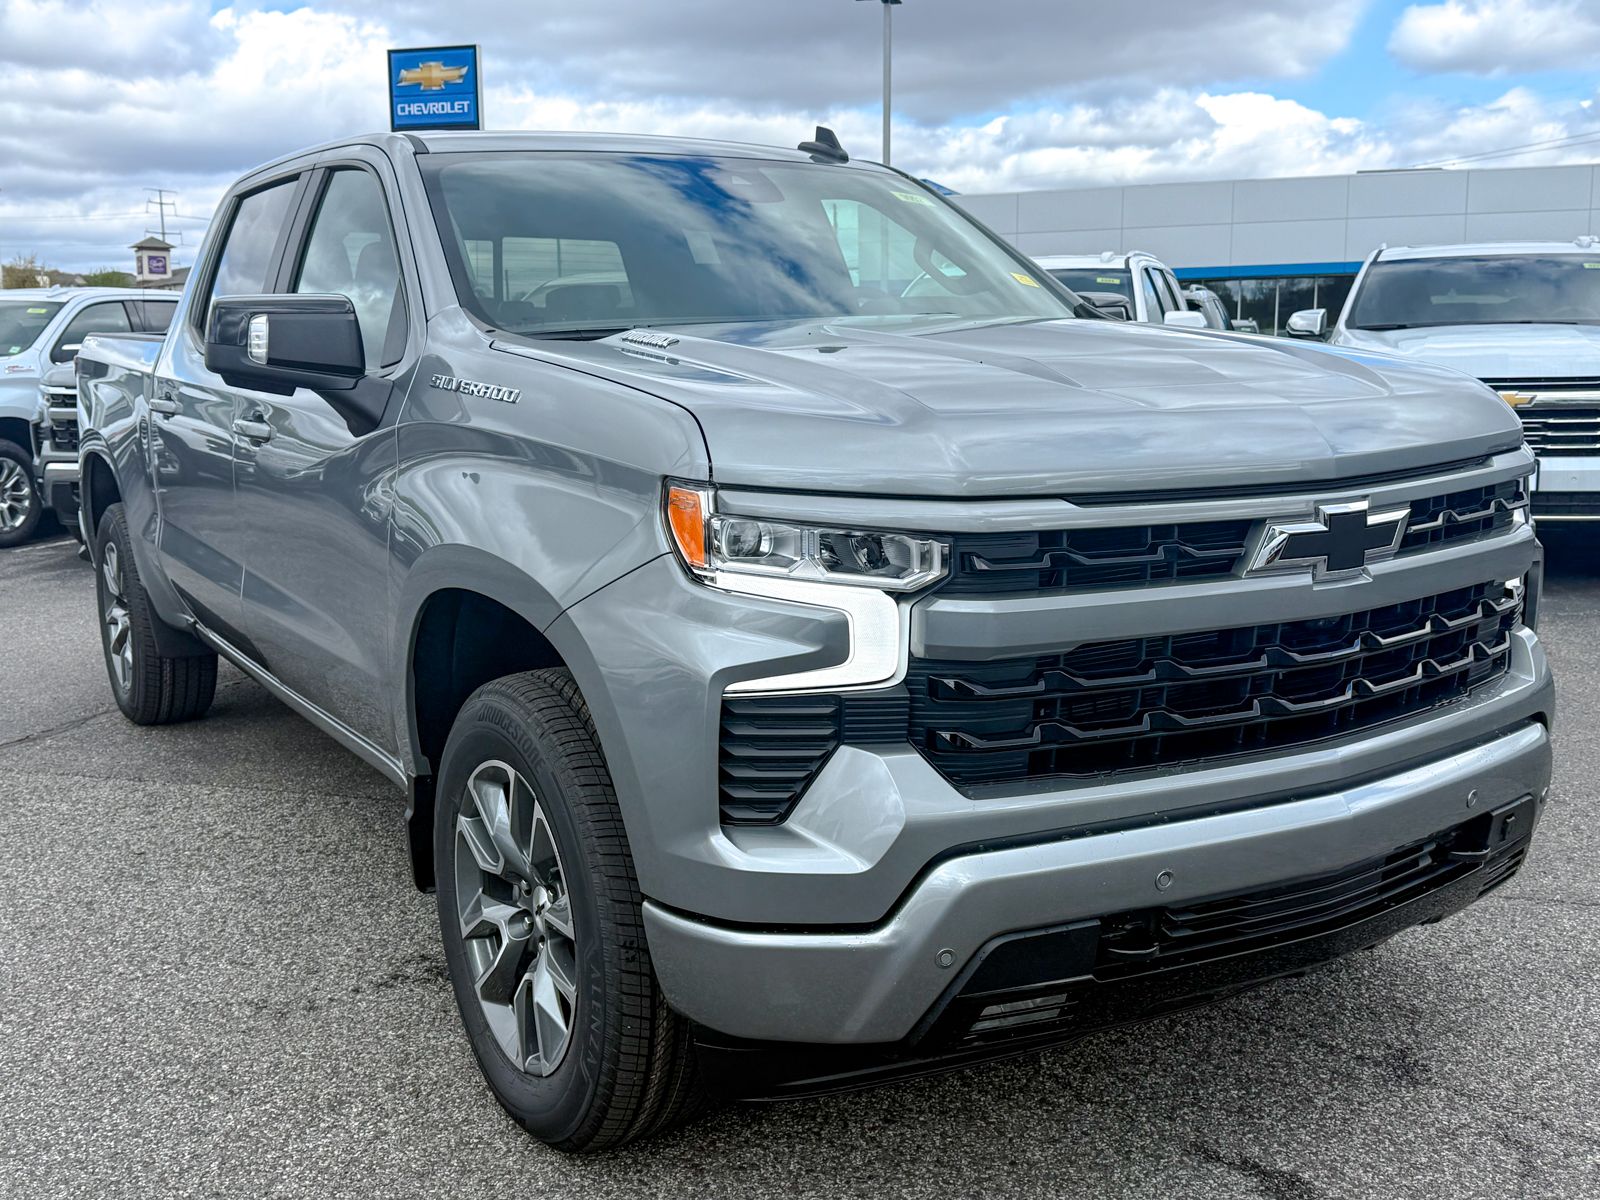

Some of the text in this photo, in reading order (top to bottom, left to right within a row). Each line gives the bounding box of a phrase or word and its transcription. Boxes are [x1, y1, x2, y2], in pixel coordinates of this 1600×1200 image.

[397, 101, 470, 116] CHEVROLET
[430, 374, 521, 404] SILVERADO
[478, 702, 546, 775] BRIDGESTONE
[587, 963, 602, 1066] ALENZA
